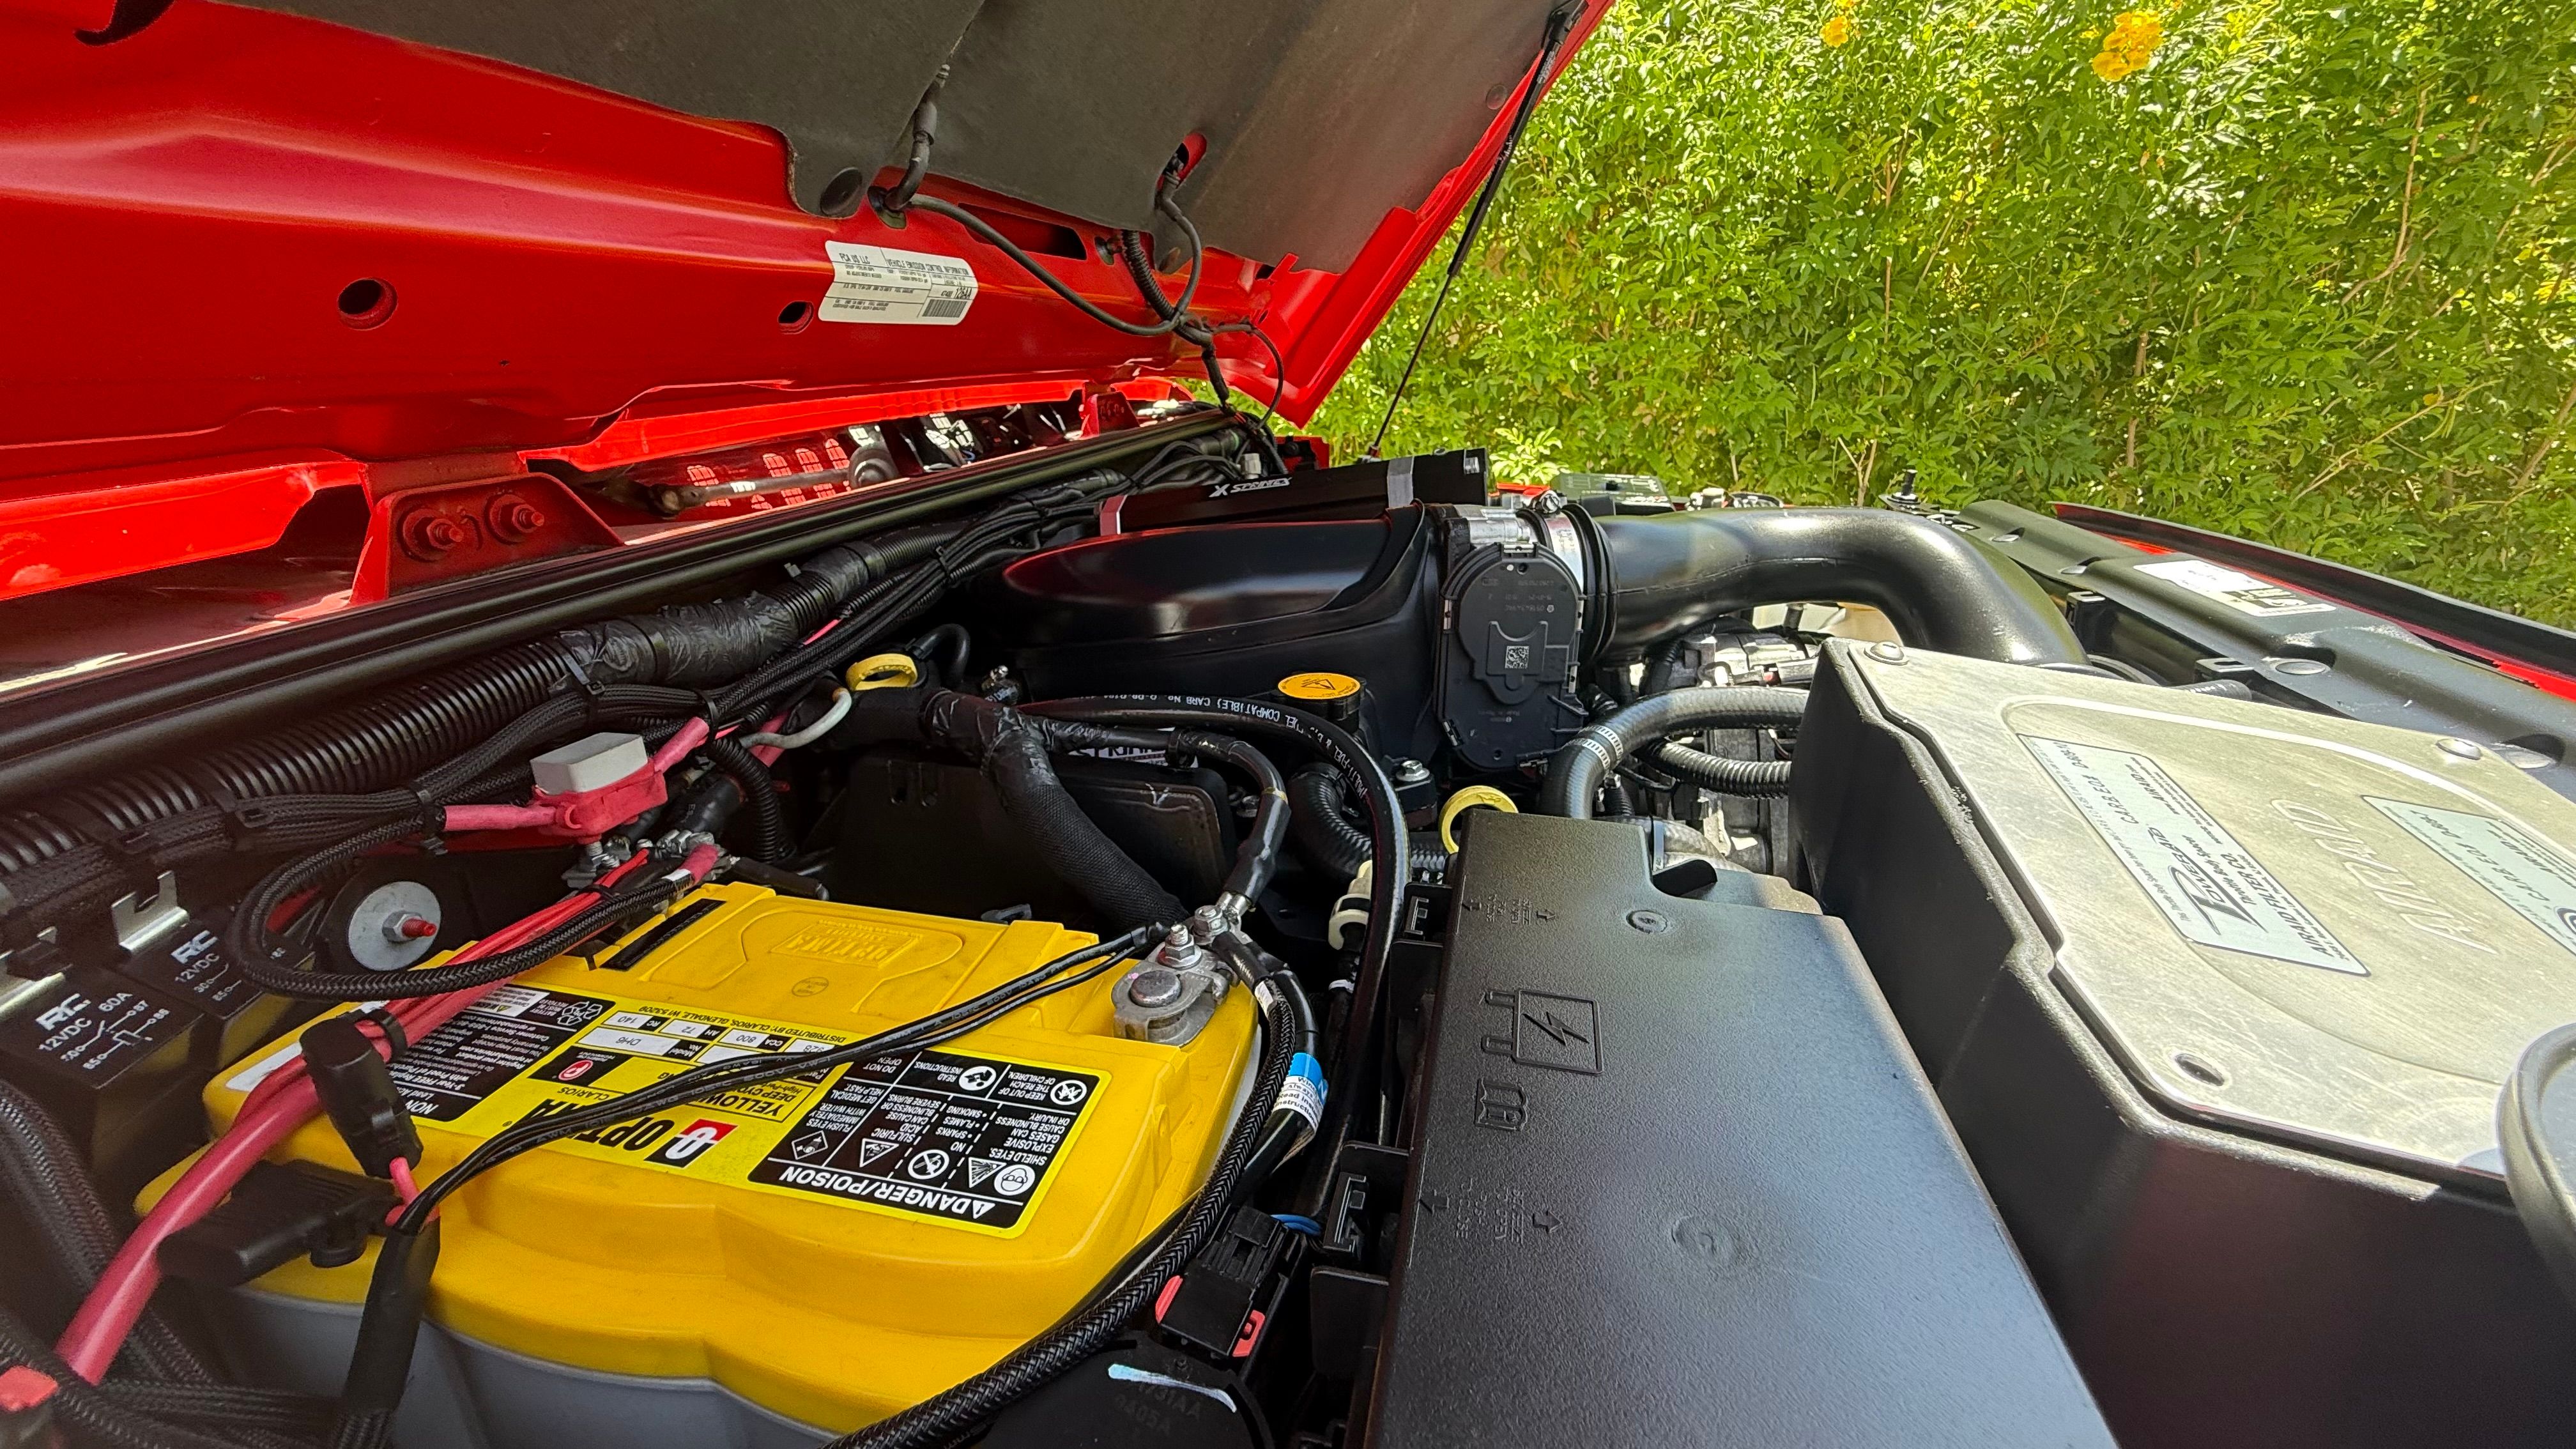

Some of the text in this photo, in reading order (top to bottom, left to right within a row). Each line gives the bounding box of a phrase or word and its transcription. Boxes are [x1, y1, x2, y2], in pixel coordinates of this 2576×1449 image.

[2237, 871, 2285, 909] FILTER
[2277, 911, 2333, 956] AIRAID
[171, 930, 218, 964] RC
[174, 953, 220, 983] 12VDC
[35, 992, 92, 1031] RC
[638, 1006, 669, 1015] 53209
[38, 991, 134, 1052] 12VDC 60A
[617, 1015, 637, 1023] 140
[680, 1025, 696, 1034] 72
[785, 1028, 846, 1043] DISTRIBUTED
[615, 1036, 641, 1046] DH6
[735, 1034, 756, 1043] 800
[763, 1038, 783, 1046] CCA
[668, 1048, 695, 1057] Model
[862, 1062, 883, 1071] NOT
[877, 1057, 902, 1066] OPEN
[411, 1075, 438, 1085] FREE
[937, 1073, 957, 1082] READ
[1008, 1071, 1045, 1083] CHILDREN.
[862, 1087, 884, 1096] HELP
[1009, 1080, 1050, 1092] THE REACH
[406, 1090, 434, 1100] Lead
[557, 1087, 610, 1100] CLARIOS
[761, 1091, 796, 1102] DEEP
[830, 1089, 877, 1104] GET MEDICAL
[997, 1087, 1046, 1100] KEEP OUT OF
[887, 1093, 941, 1108] SEVERE BURNS.
[844, 1107, 866, 1116] WITH
[880, 1101, 935, 1116] BLINDNESS OR
[946, 1105, 982, 1117] SMOKING
[809, 1110, 860, 1124] IMMEDIATELY
[885, 1111, 929, 1124] CAN CAUSE
[942, 1116, 975, 1128] FLAMES
[1029, 1112, 1070, 1126] OR INJURY.
[806, 1117, 853, 1132] FLUSH EYES
[900, 1123, 923, 1133] ACID
[995, 1116, 1065, 1134] CAUSE BLINDNESS
[871, 1128, 915, 1142] SULFURIC
[935, 1126, 967, 1138] SPARKS
[1010, 1128, 1060, 1143] GASES CAN
[950, 1141, 966, 1152] NO
[1003, 1137, 1054, 1153] EXPLOSIVE
[988, 1147, 1047, 1165] SHIELD EYES.
[780, 1167, 970, 1213] DANGER/POISON
